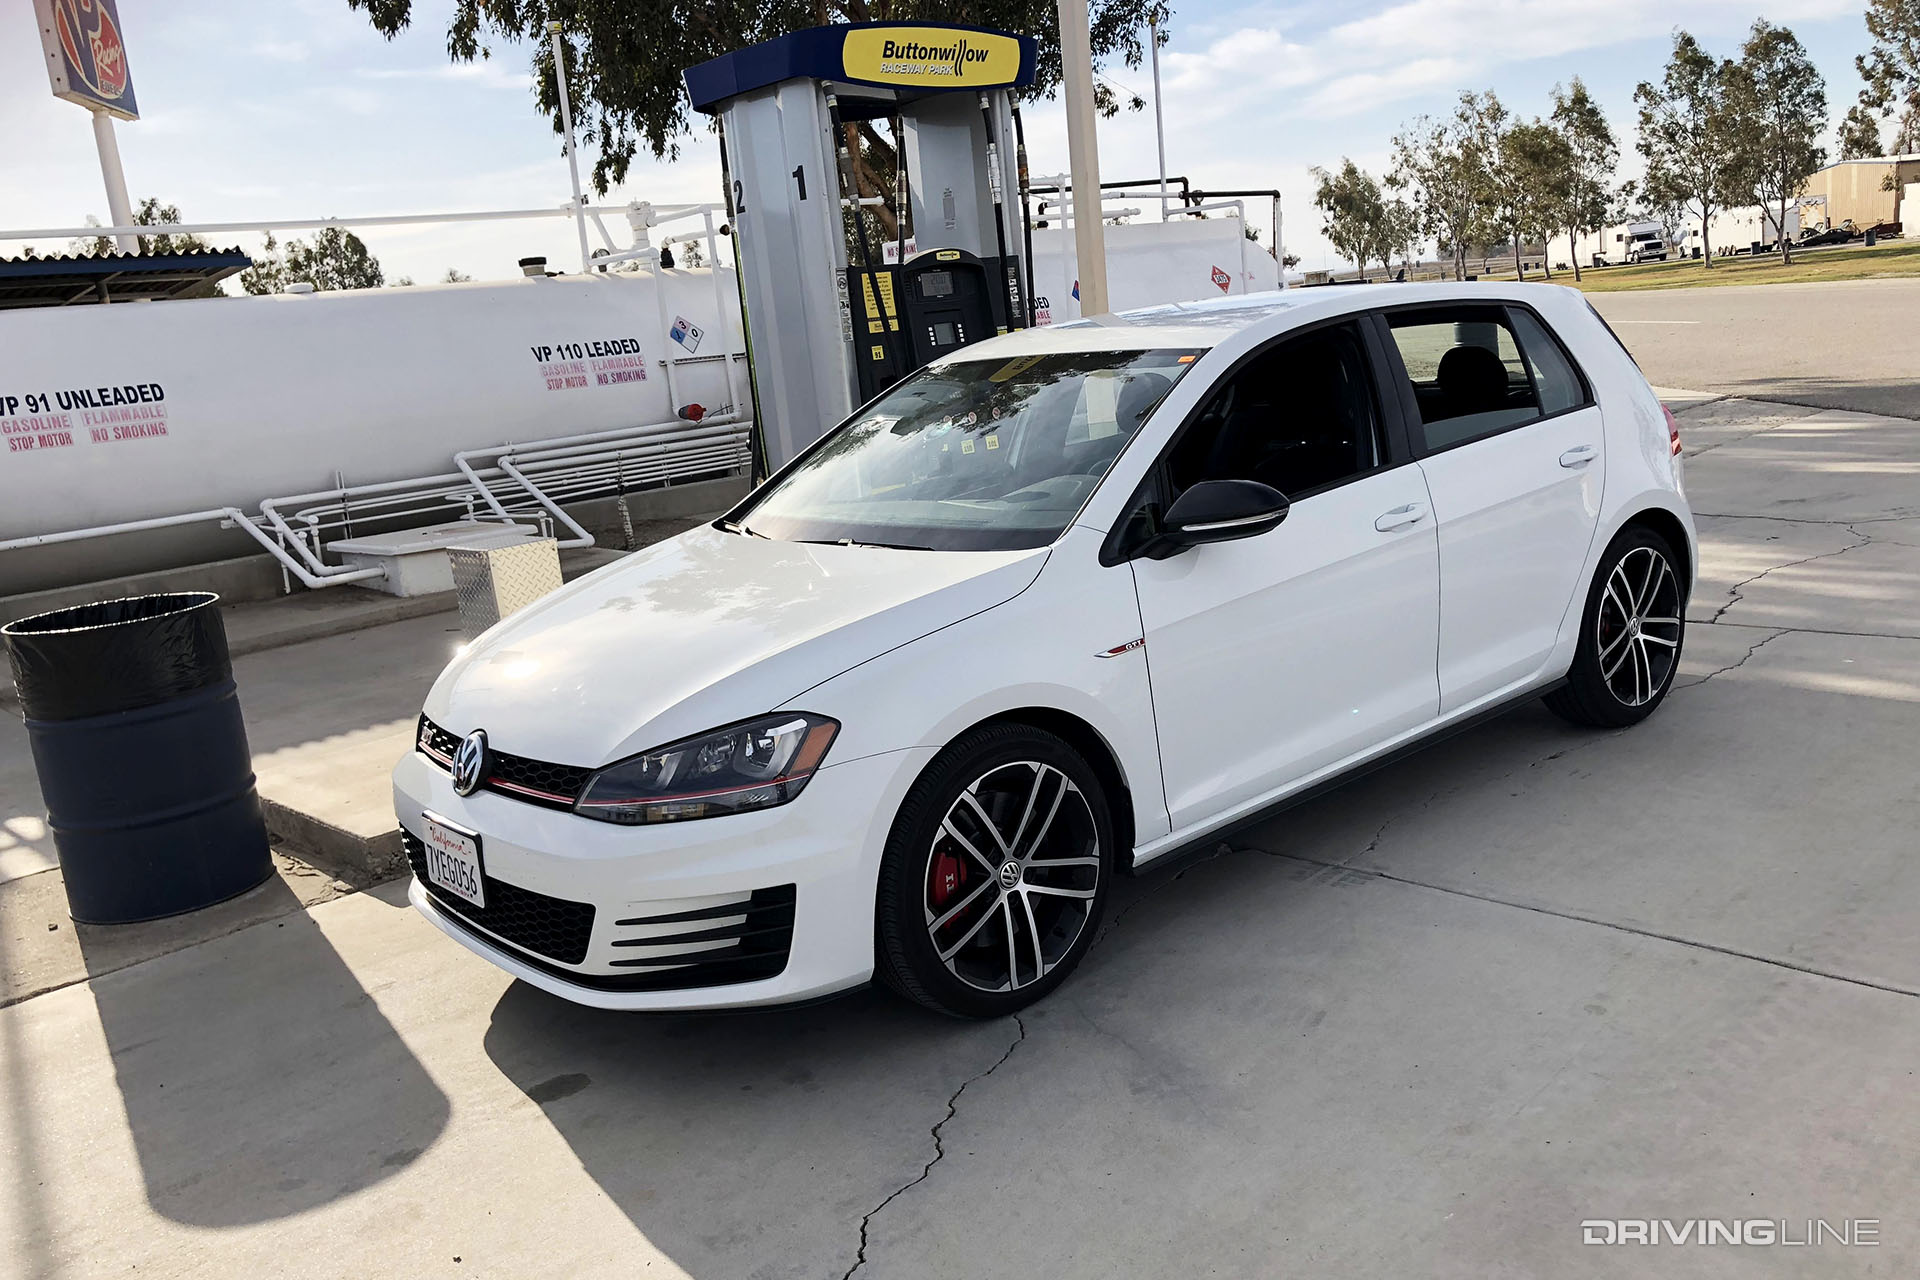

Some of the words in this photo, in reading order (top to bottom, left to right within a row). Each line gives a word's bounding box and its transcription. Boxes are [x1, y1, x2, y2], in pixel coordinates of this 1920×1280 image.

[880, 63, 927, 75] RACEWAY
[928, 64, 954, 75] PARK
[882, 39, 989, 77] Buttonwillow
[792, 165, 807, 201] 1
[734, 180, 746, 215] 2
[678, 320, 687, 330] 3
[691, 328, 699, 338] 0
[531, 346, 552, 362] VP
[556, 343, 583, 361] 110
[584, 338, 641, 358] LEADED
[541, 361, 586, 377] GASOLINE
[591, 356, 645, 372] FLAMMABLE
[546, 379, 563, 391] STOP
[565, 376, 588, 388] MOTOR
[597, 373, 609, 386] NO
[611, 369, 646, 383] SMOKING
[25, 393, 51, 414] 91
[55, 383, 165, 411] UNLEADED
[1, 415, 71, 434] GASOLINE
[84, 404, 165, 426] FLAMMABLE
[9, 436, 35, 452] STOP
[38, 431, 73, 448] MOTOR
[91, 427, 109, 442] NO
[113, 421, 167, 440] SMOKING
[1125, 640, 1142, 651] GTI
[432, 827, 466, 853] California
[427, 843, 477, 895] 7YEG056
